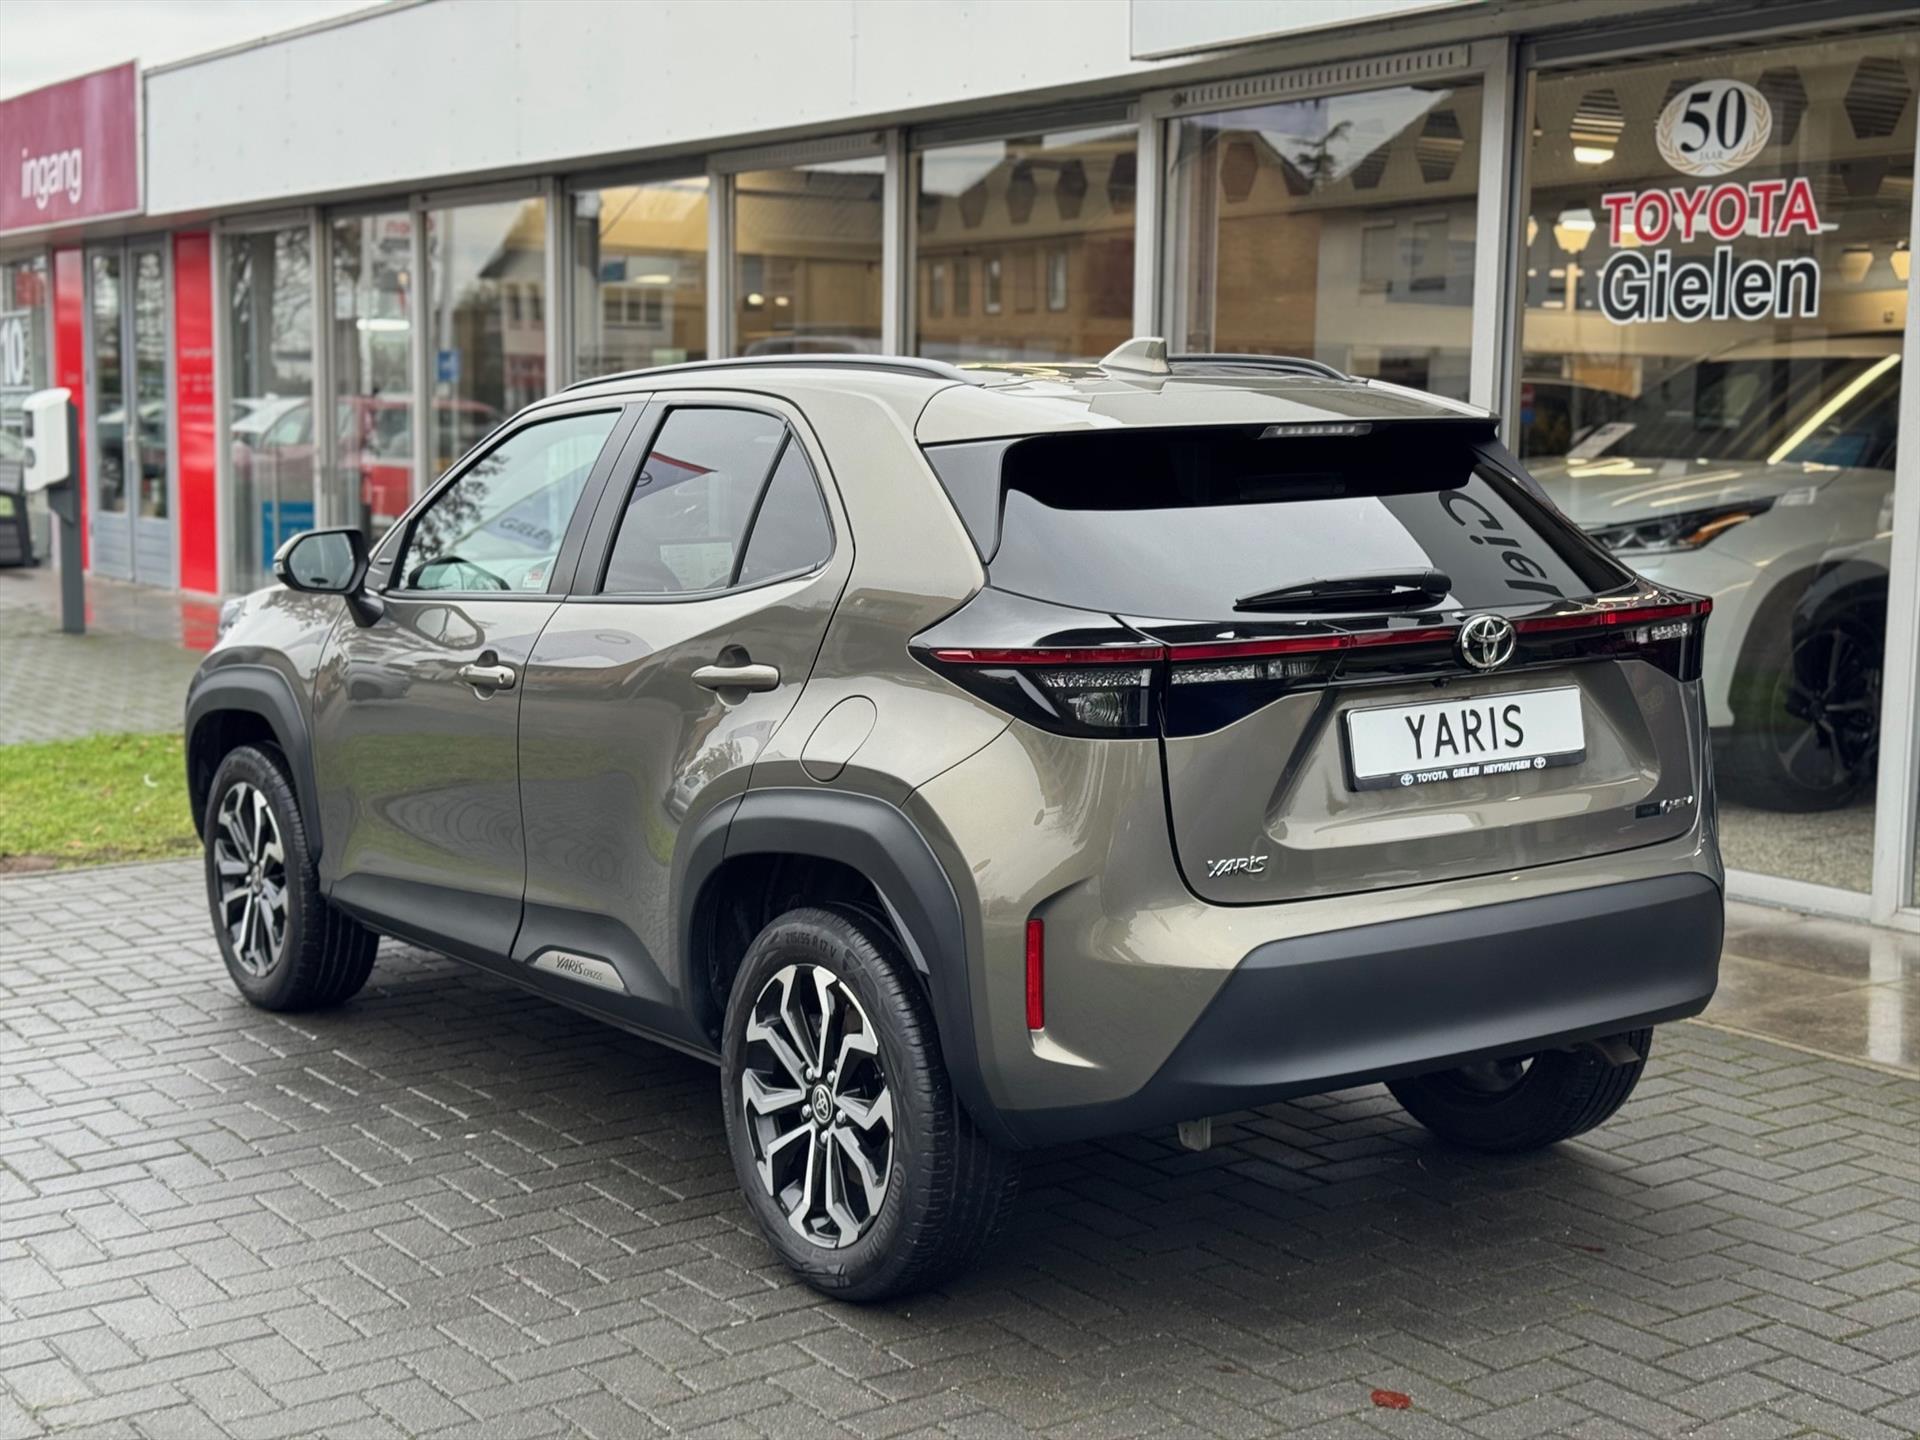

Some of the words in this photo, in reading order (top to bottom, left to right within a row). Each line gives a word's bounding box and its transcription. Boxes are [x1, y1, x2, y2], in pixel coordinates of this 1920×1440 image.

[1680, 86, 1748, 154] 50
[21, 147, 82, 210] ingang
[1602, 177, 1823, 247] TOYOTA
[1599, 246, 1821, 325] Gielen
[1404, 704, 1525, 760] YARIS
[1416, 770, 1449, 784] TOYOTA
[1453, 765, 1480, 779] GIELEN
